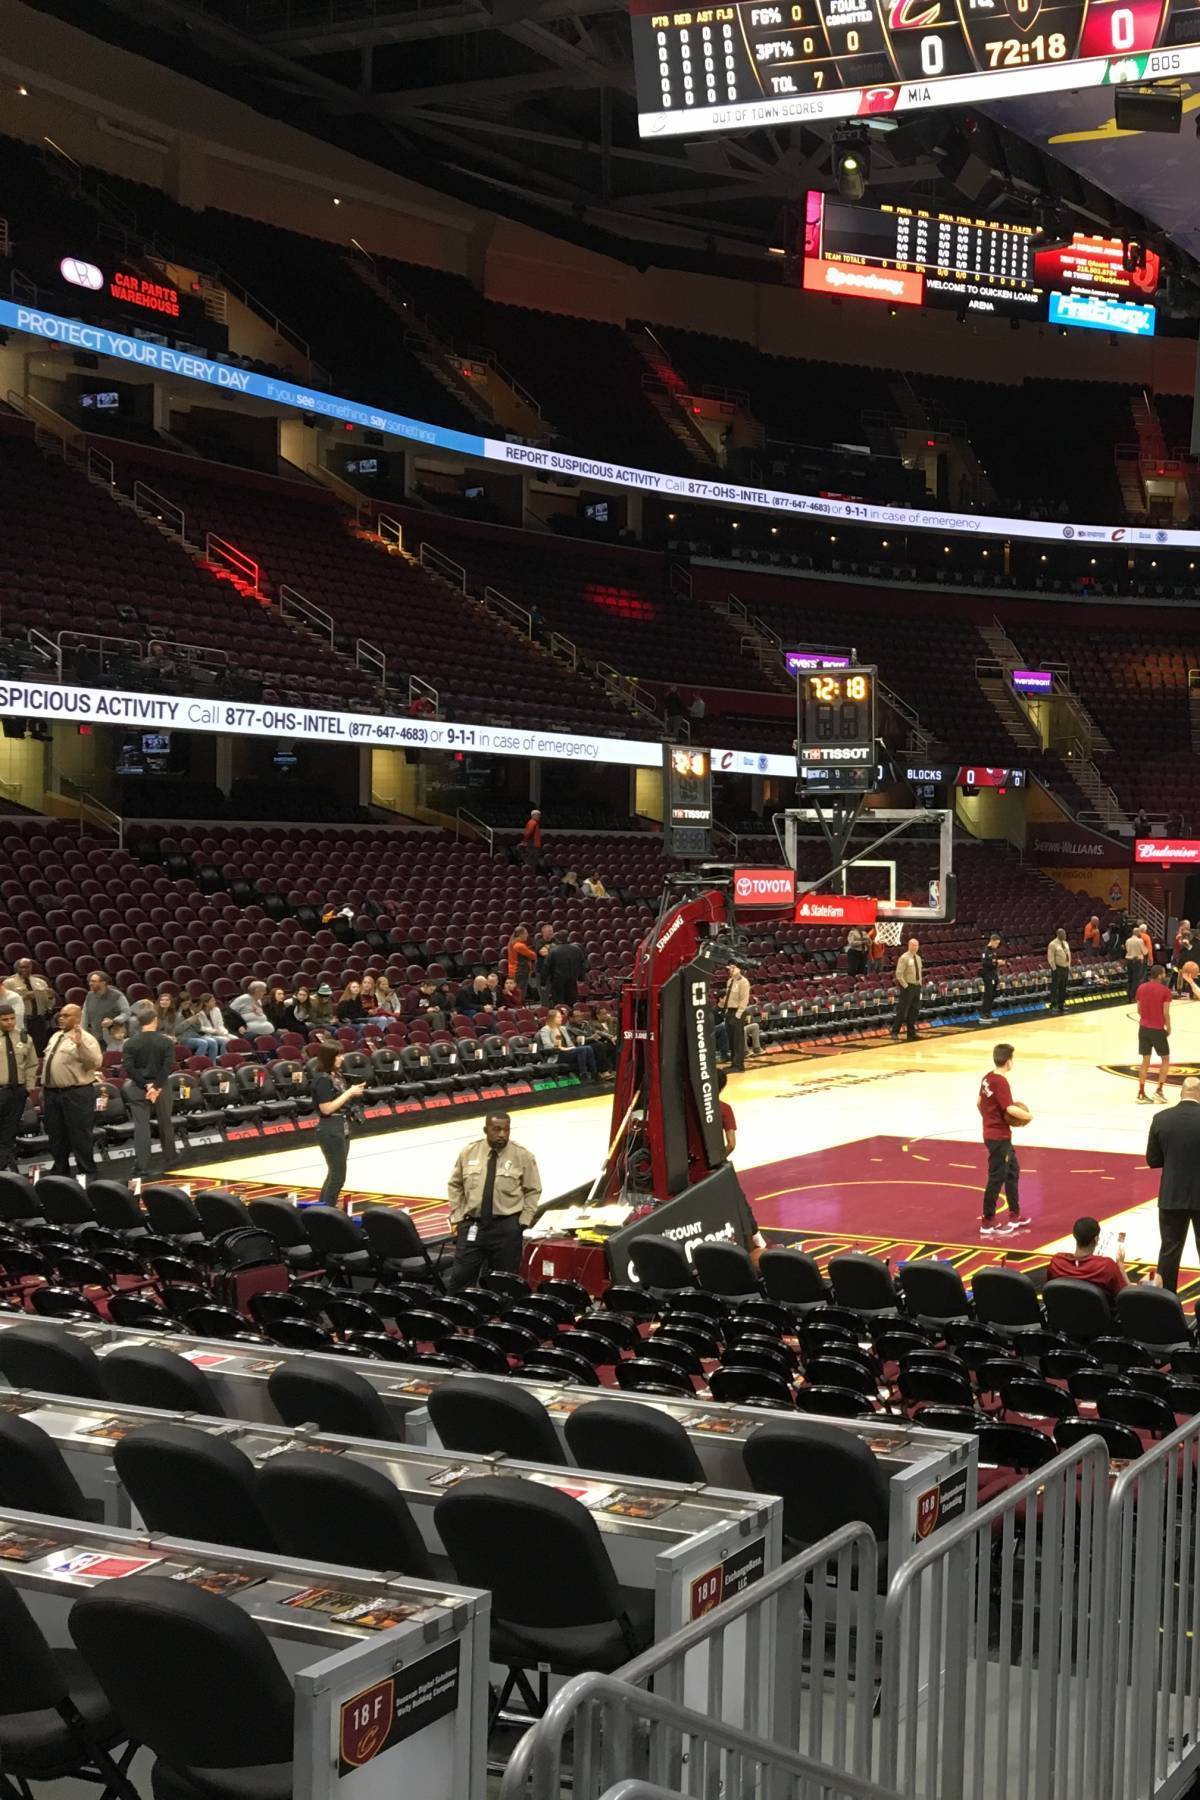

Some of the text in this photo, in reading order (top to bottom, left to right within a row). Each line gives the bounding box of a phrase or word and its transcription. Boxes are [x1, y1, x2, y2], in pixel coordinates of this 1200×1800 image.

[791, 5, 802, 21] 0
[1110, 9, 1135, 49] 0
[756, 37, 814, 60] 3PT% 0
[847, 31, 859, 51] 0
[985, 33, 1066, 67] 72:18
[921, 35, 943, 75] 0
[1151, 54, 1180, 72] BOS
[771, 71, 824, 93] TOL 7
[908, 87, 931, 103] MIA
[712, 102, 824, 124] OUT OF TOWN SCORES
[825, 252, 866, 265] TEAM TOTALS
[114, 272, 178, 303] CAR PARTS
[926, 278, 1039, 303] WELCOME TO QUICKEN LOANS
[110, 284, 180, 317] WAREHOUSE
[968, 299, 994, 311] ARENA
[17, 308, 251, 391] PROTECT YOUR EVERY DAY
[296, 394, 316, 408] see
[370, 415, 387, 430] say
[505, 446, 982, 531] REPORT SUSPICIOUS ACTIVITY Call 877-OHS-INTEL (877-647-4683) or 9-1-1 in case of emergency
[810, 676, 865, 701] 72:18
[95, 694, 179, 721] ACTIVITY
[187, 703, 221, 725] Call
[225, 707, 346, 736] 877-OHS-INTEL
[347, 720, 428, 745] (877-647-4683)
[430, 731, 444, 743] or
[446, 728, 476, 746] 9-1-1
[479, 732, 490, 747] in
[493, 735, 520, 750] case
[523, 734, 536, 751] of
[537, 740, 599, 760] emergency
[821, 748, 870, 760] TISSOT
[906, 769, 942, 782] BLOCKS
[966, 770, 976, 784] 0
[683, 808, 711, 820] TISSOT
[1138, 843, 1198, 858] Budweiser
[752, 879, 792, 893] TOYOTA
[656, 914, 684, 953] SPALDING
[694, 1009, 714, 1124] Cleveland Clinic
[698, 1577, 717, 1603] 18 D
[737, 1576, 748, 1591] LLC
[353, 1703, 370, 1731] 18
[374, 1696, 384, 1719] F
